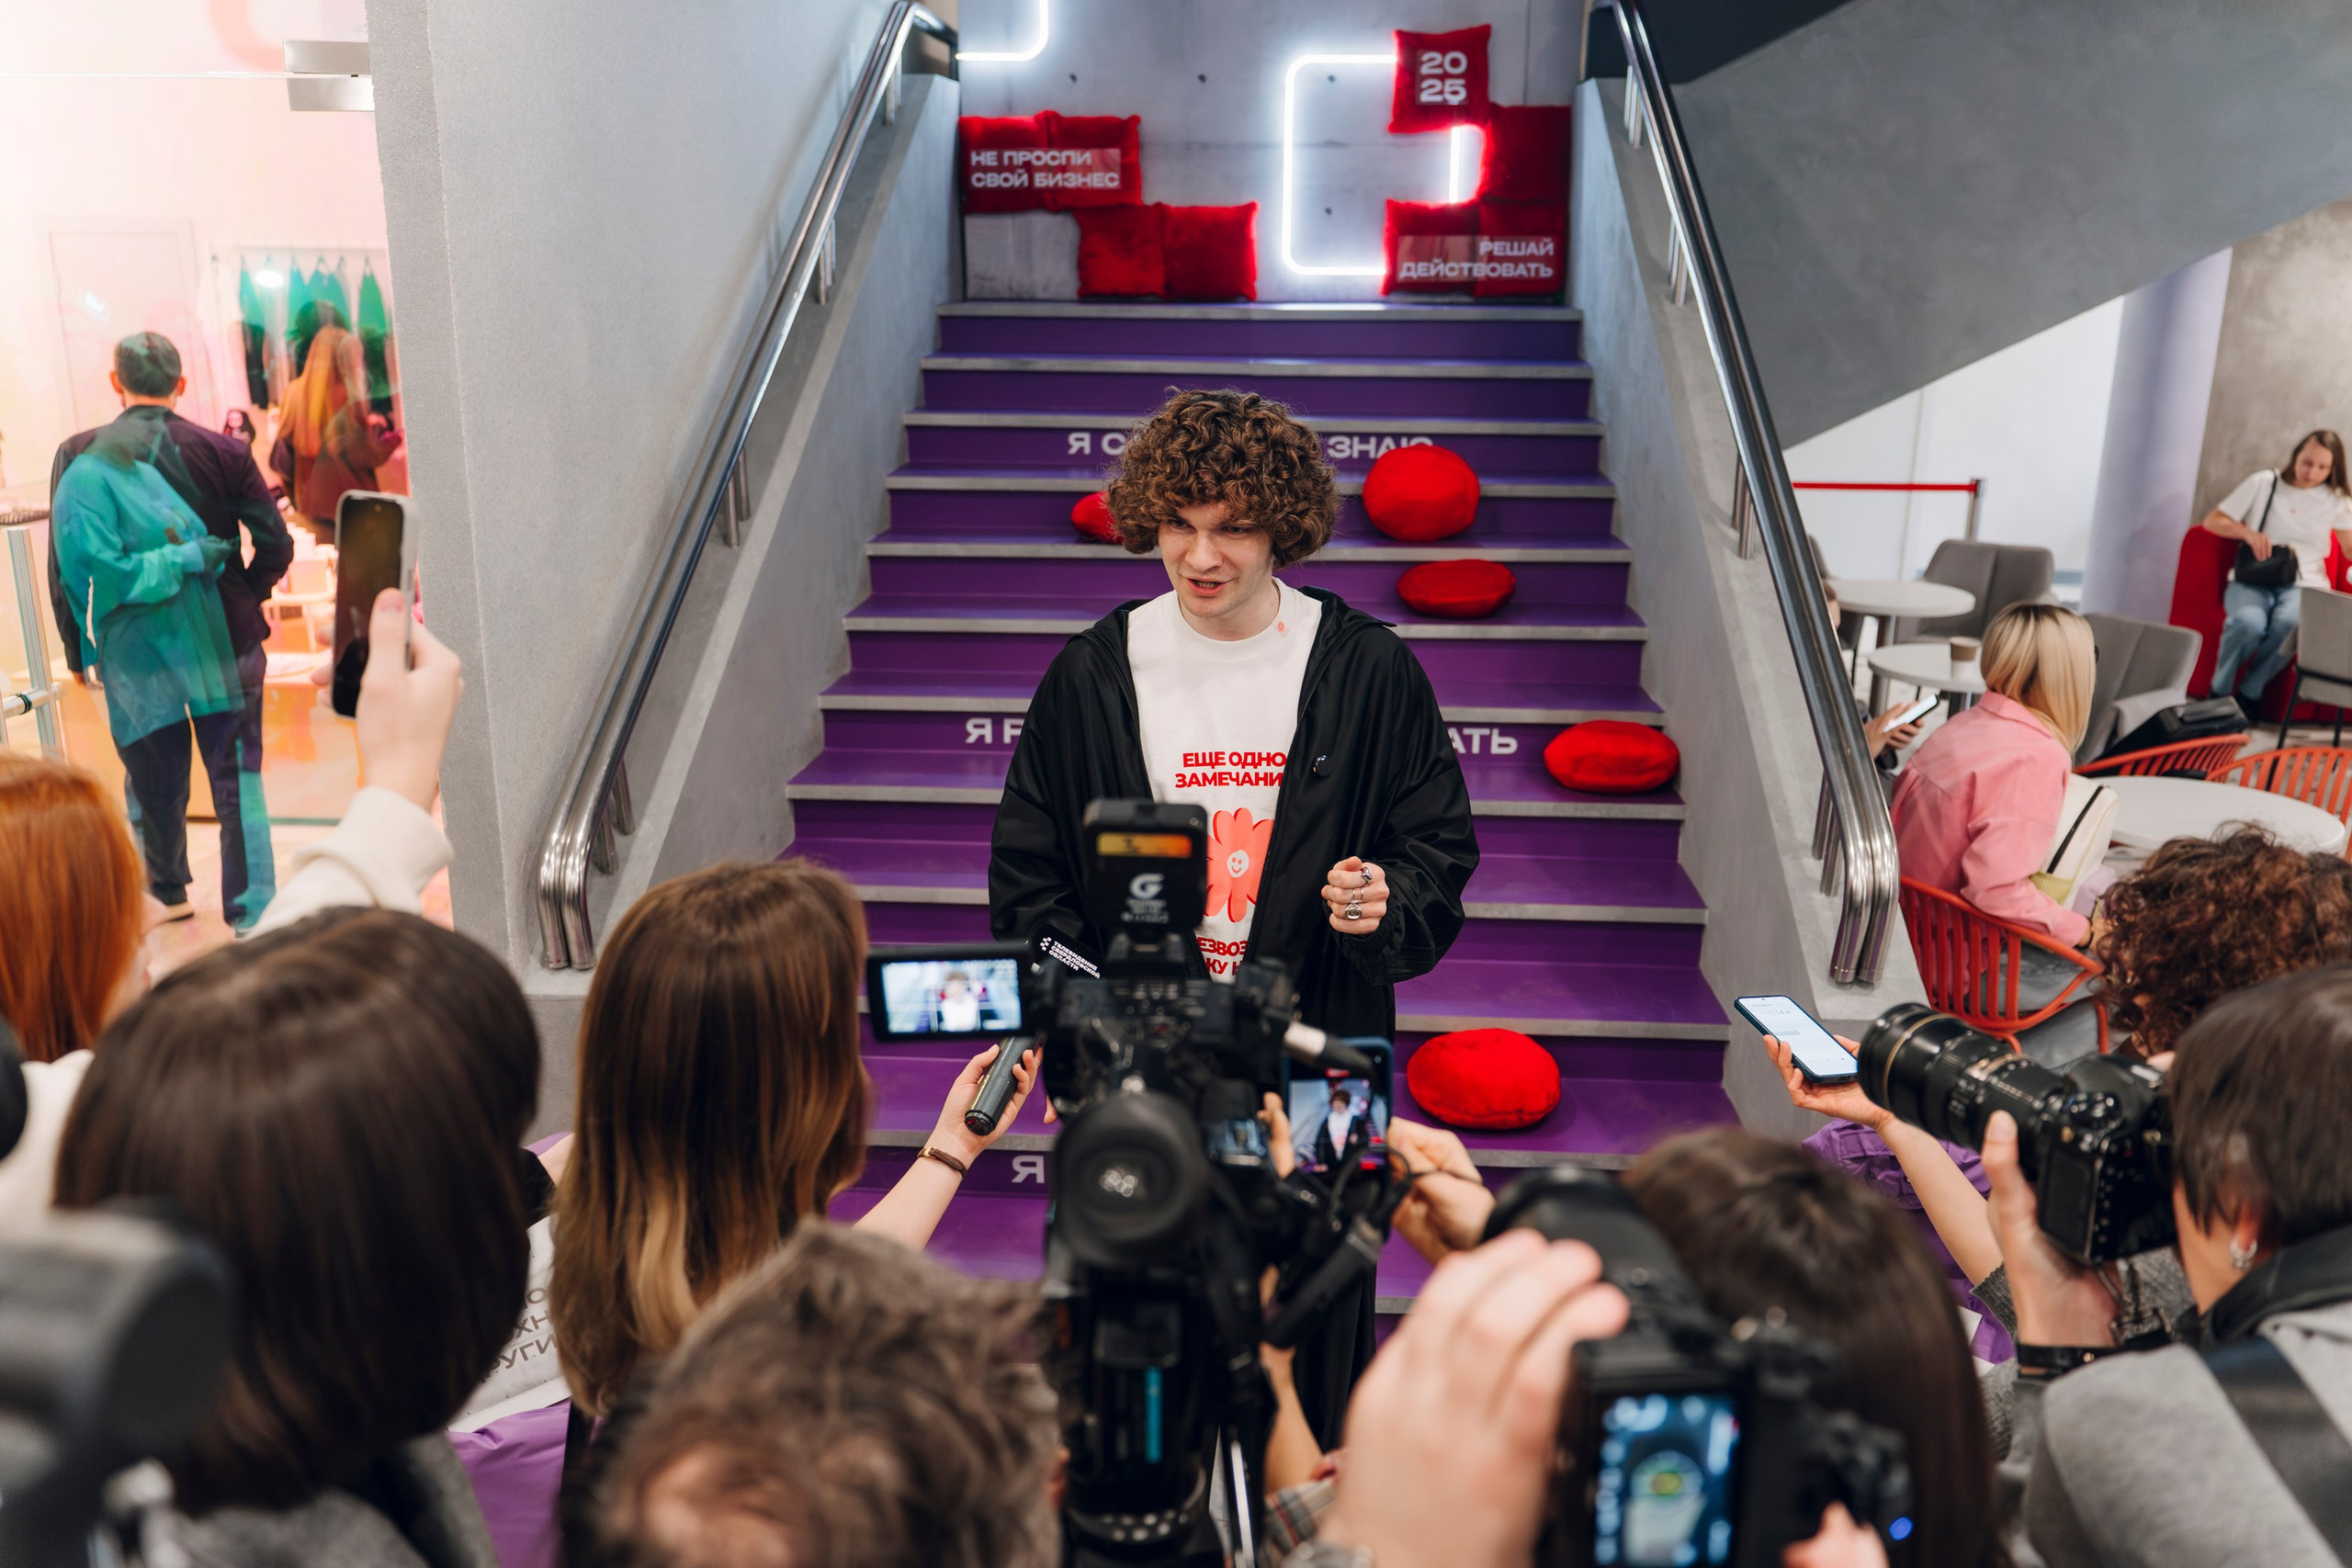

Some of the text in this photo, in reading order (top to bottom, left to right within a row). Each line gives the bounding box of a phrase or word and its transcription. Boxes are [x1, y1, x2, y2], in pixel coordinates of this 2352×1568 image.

[1419, 51, 1468, 74] 20
[1419, 78, 1467, 103] 25
[970, 150, 1091, 166] НЕ ПРОСПИ
[970, 168, 1121, 188] СВОЙ БИЗНЕС
[1398, 237, 1555, 280] РЕШАЙ ДЕЙСТВОВАТЬ
[1068, 432, 1091, 456] Я
[1101, 432, 1127, 457] С
[966, 717, 993, 745] Я
[1447, 727, 1519, 755] АТЬ
[1182, 751, 1287, 770] ЕЩЕ ОДНО
[1175, 772, 1284, 789] ЗАМЕЧАНИ
[1054, 941, 1098, 971] ТЕЛЕВИДЕНИЕ
[1197, 937, 1248, 957] ЕЗВОЗ
[1048, 950, 1080, 971] ОБЛАСТИ
[1051, 945, 1101, 979] СВЕРДЛОВСКОЙ
[1205, 957, 1228, 975] КУ
[1011, 1155, 1046, 1184] Я
